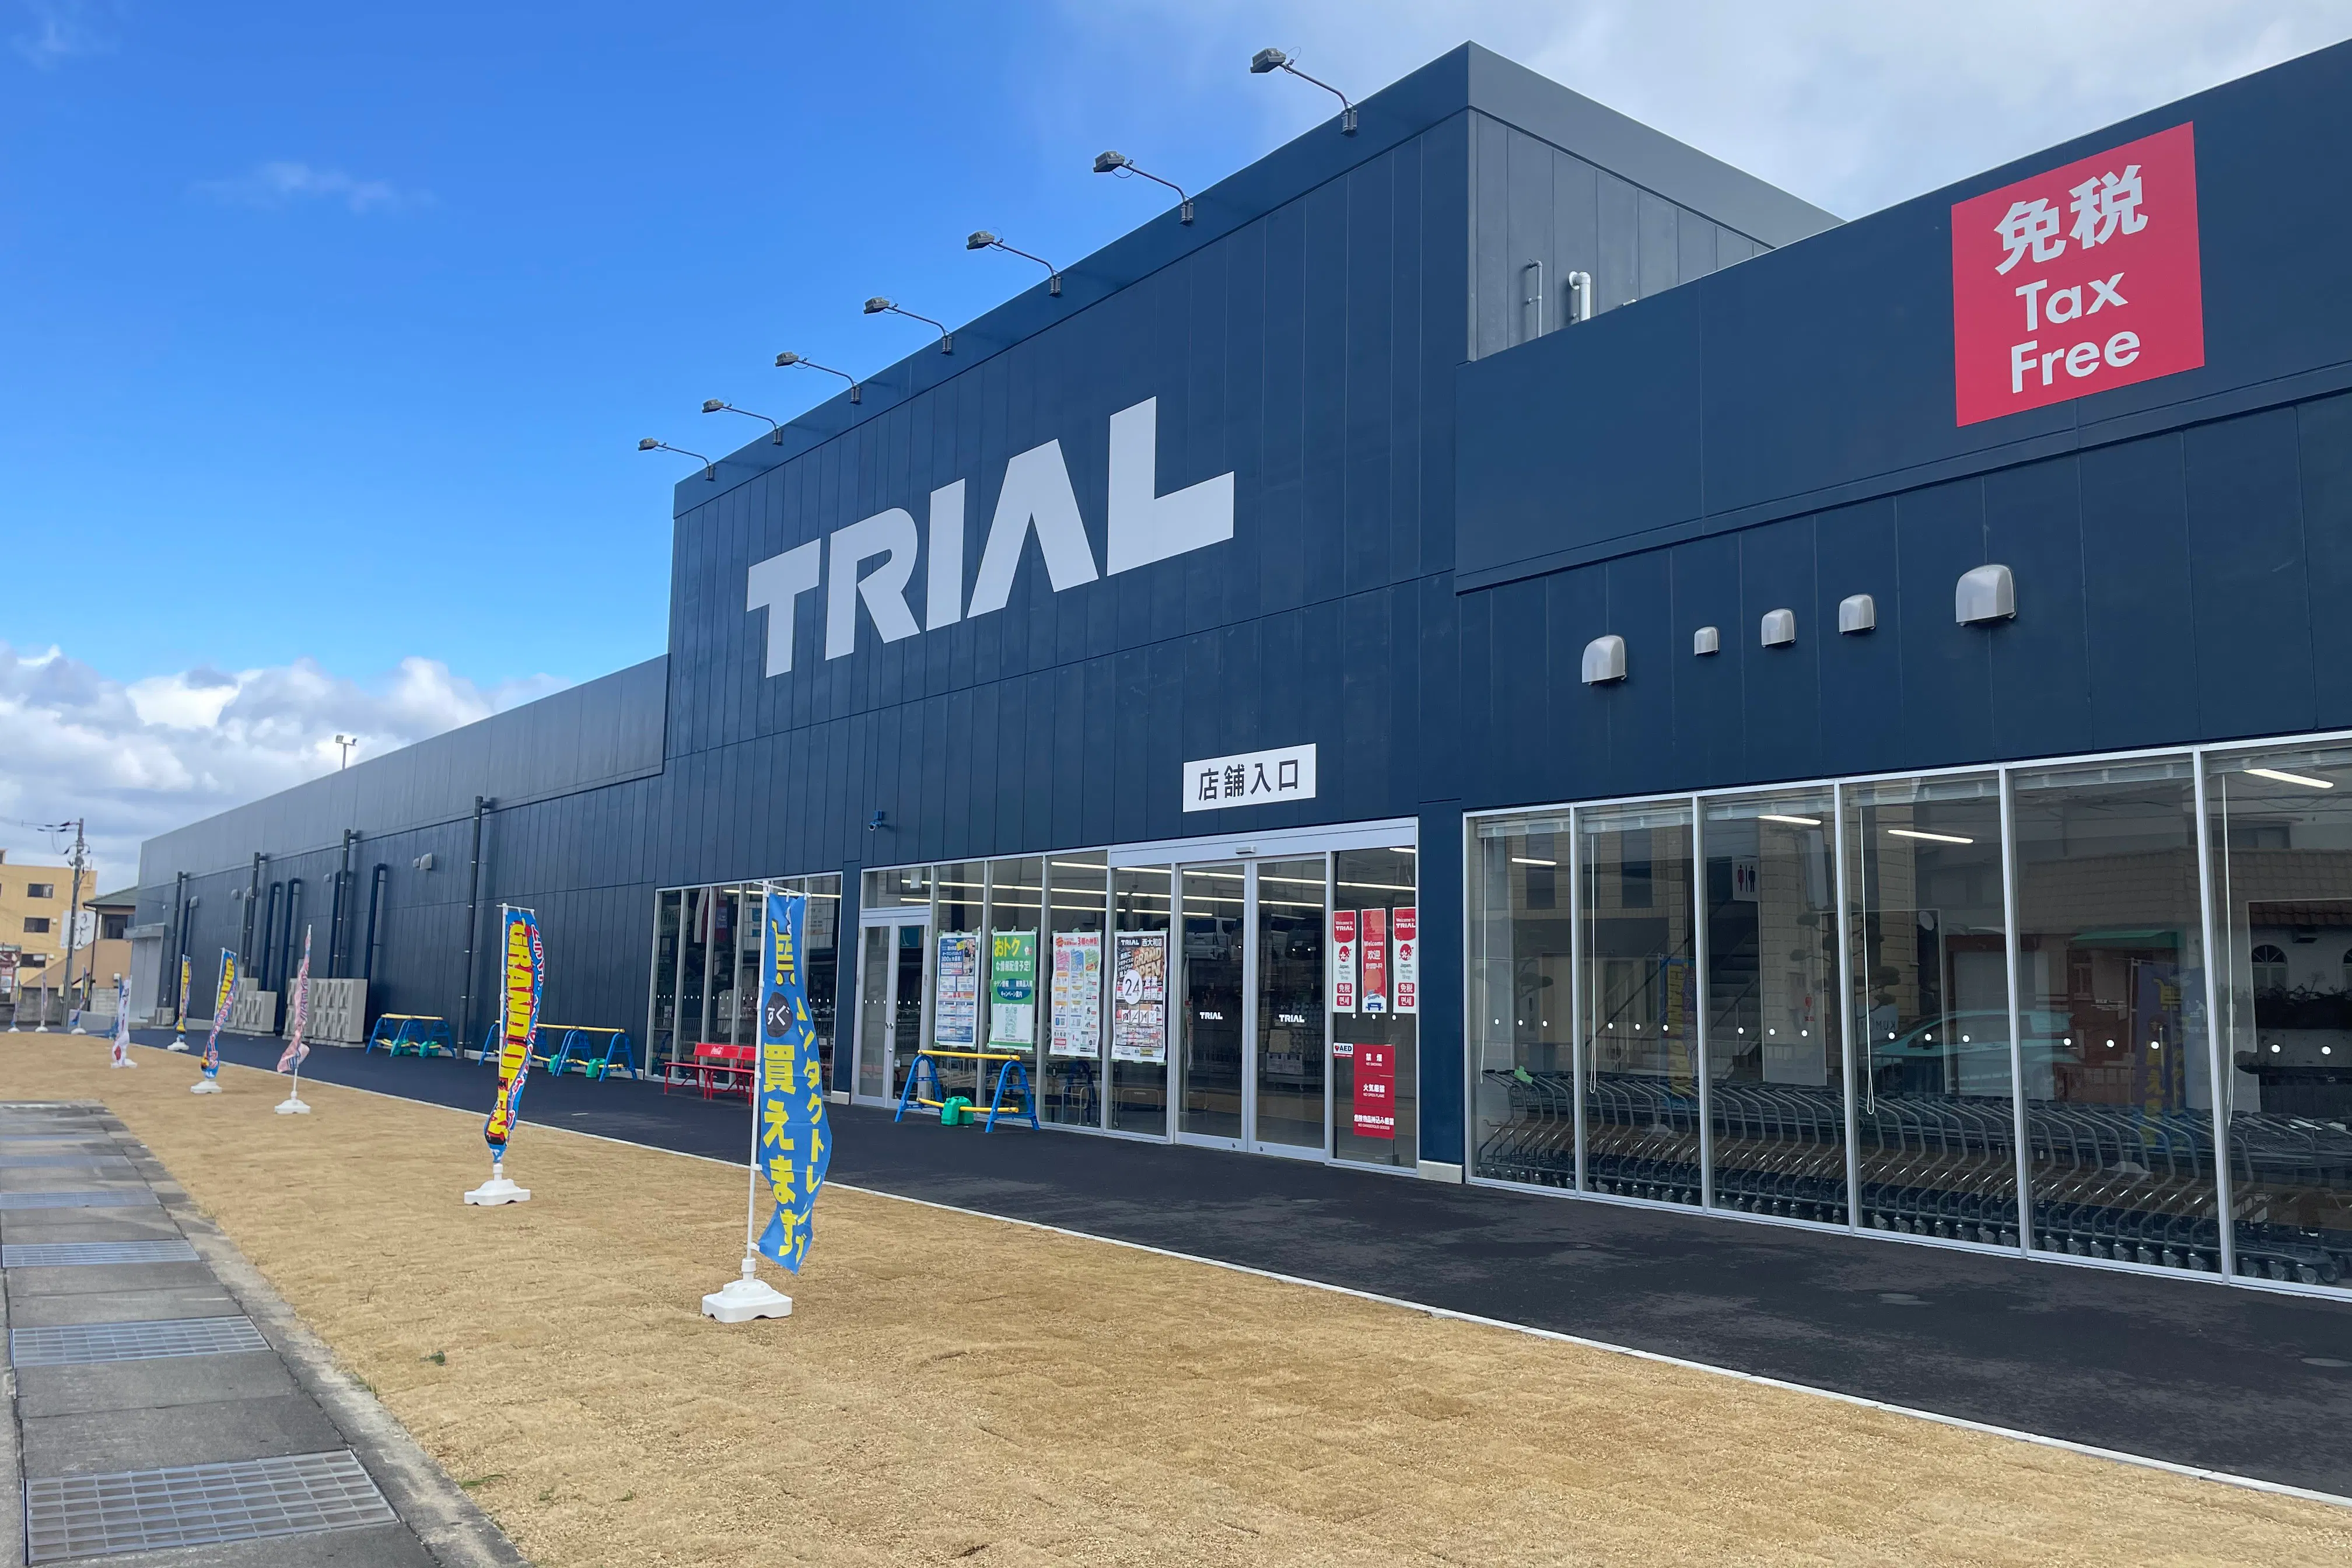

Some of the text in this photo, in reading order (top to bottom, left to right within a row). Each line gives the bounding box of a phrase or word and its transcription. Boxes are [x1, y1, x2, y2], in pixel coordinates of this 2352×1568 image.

[1993, 164, 2148, 275] 免税
[2015, 272, 2129, 331] Tax
[2011, 331, 2141, 393] Free
[747, 396, 1234, 678] TRIAL
[1198, 759, 1298, 801] 店舗入口
[994, 937, 1021, 957] おトク
[1142, 938, 1163, 947] 西大和店
[1133, 947, 1162, 967] GRAND
[506, 918, 532, 1037] GRAND
[1125, 978, 1140, 997] 24
[1339, 984, 1350, 992] 免税
[1400, 984, 1413, 993] 免税
[767, 1005, 790, 1026] すぐ
[1199, 1012, 1223, 1020] TRIAL
[1279, 1014, 1305, 1023] TRIAL
[1363, 1083, 1385, 1093] 火気厳禁
[762, 1042, 798, 1256] 買えます
